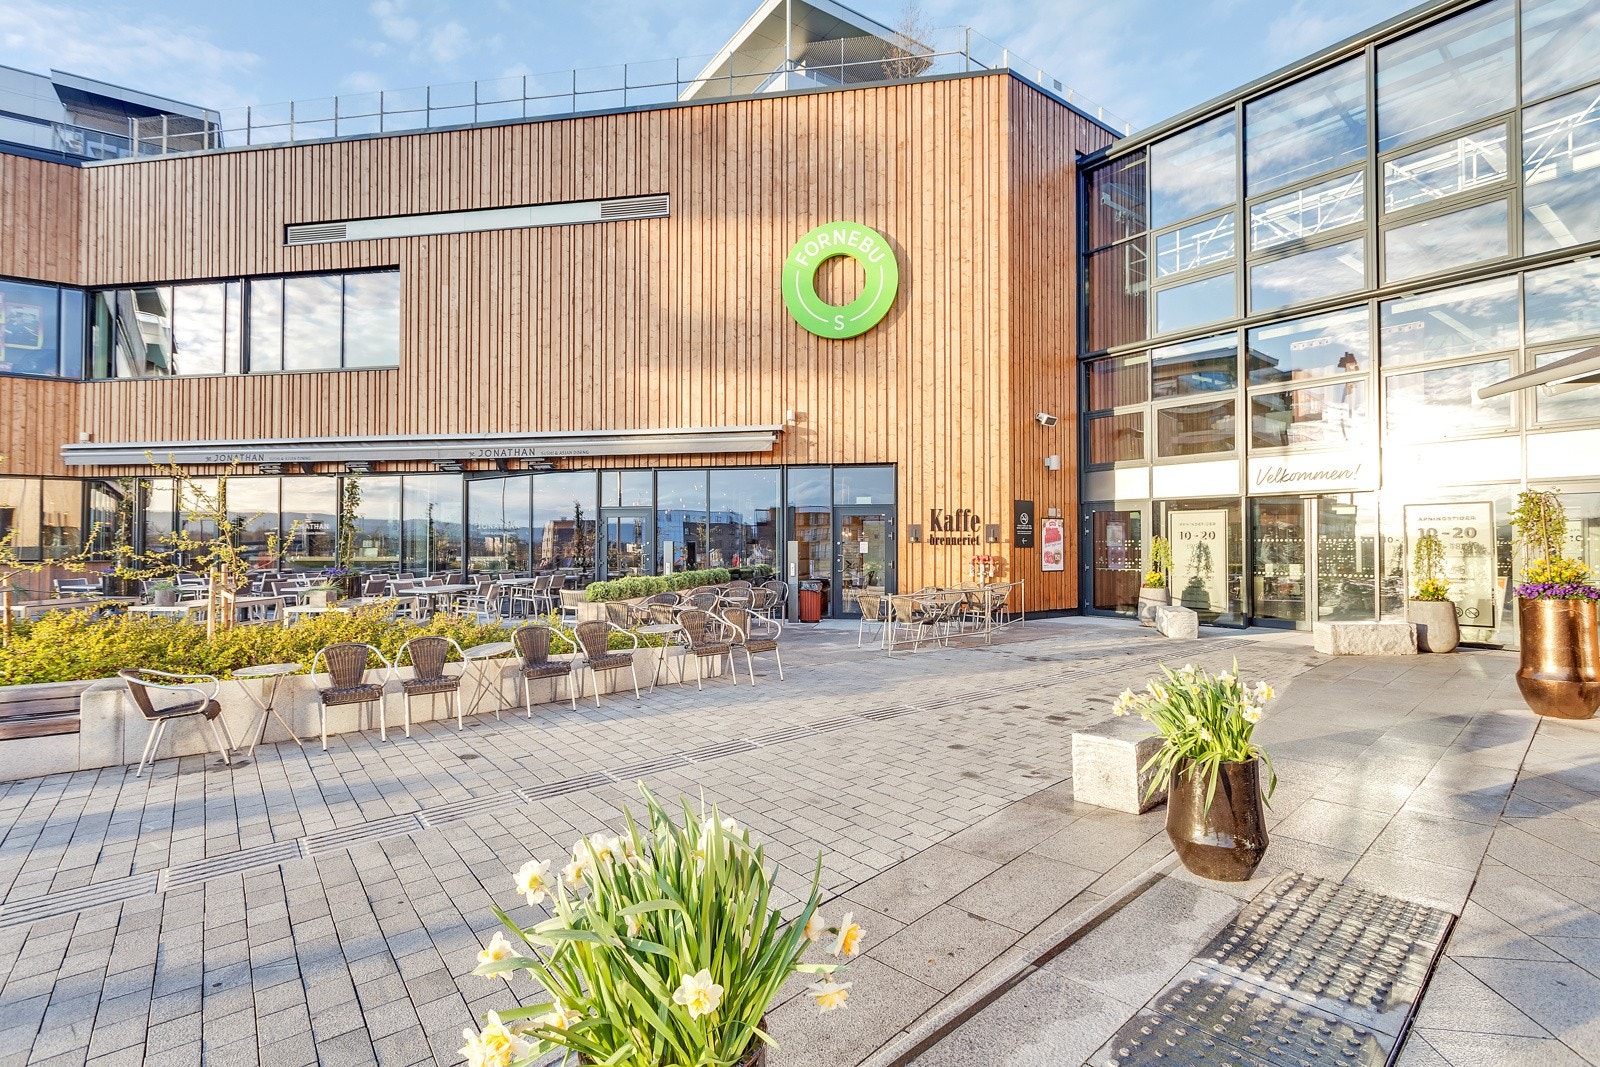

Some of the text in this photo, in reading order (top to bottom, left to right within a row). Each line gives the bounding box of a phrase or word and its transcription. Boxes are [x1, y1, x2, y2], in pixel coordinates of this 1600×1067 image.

[795, 229, 885, 266] FORNEBU
[834, 315, 845, 330] S
[214, 453, 265, 461] JONATHAN
[478, 448, 536, 457] JONATHAN
[1256, 464, 1361, 486] Velkommen!
[930, 508, 981, 532] Kaffe
[929, 534, 981, 546] brenneriet
